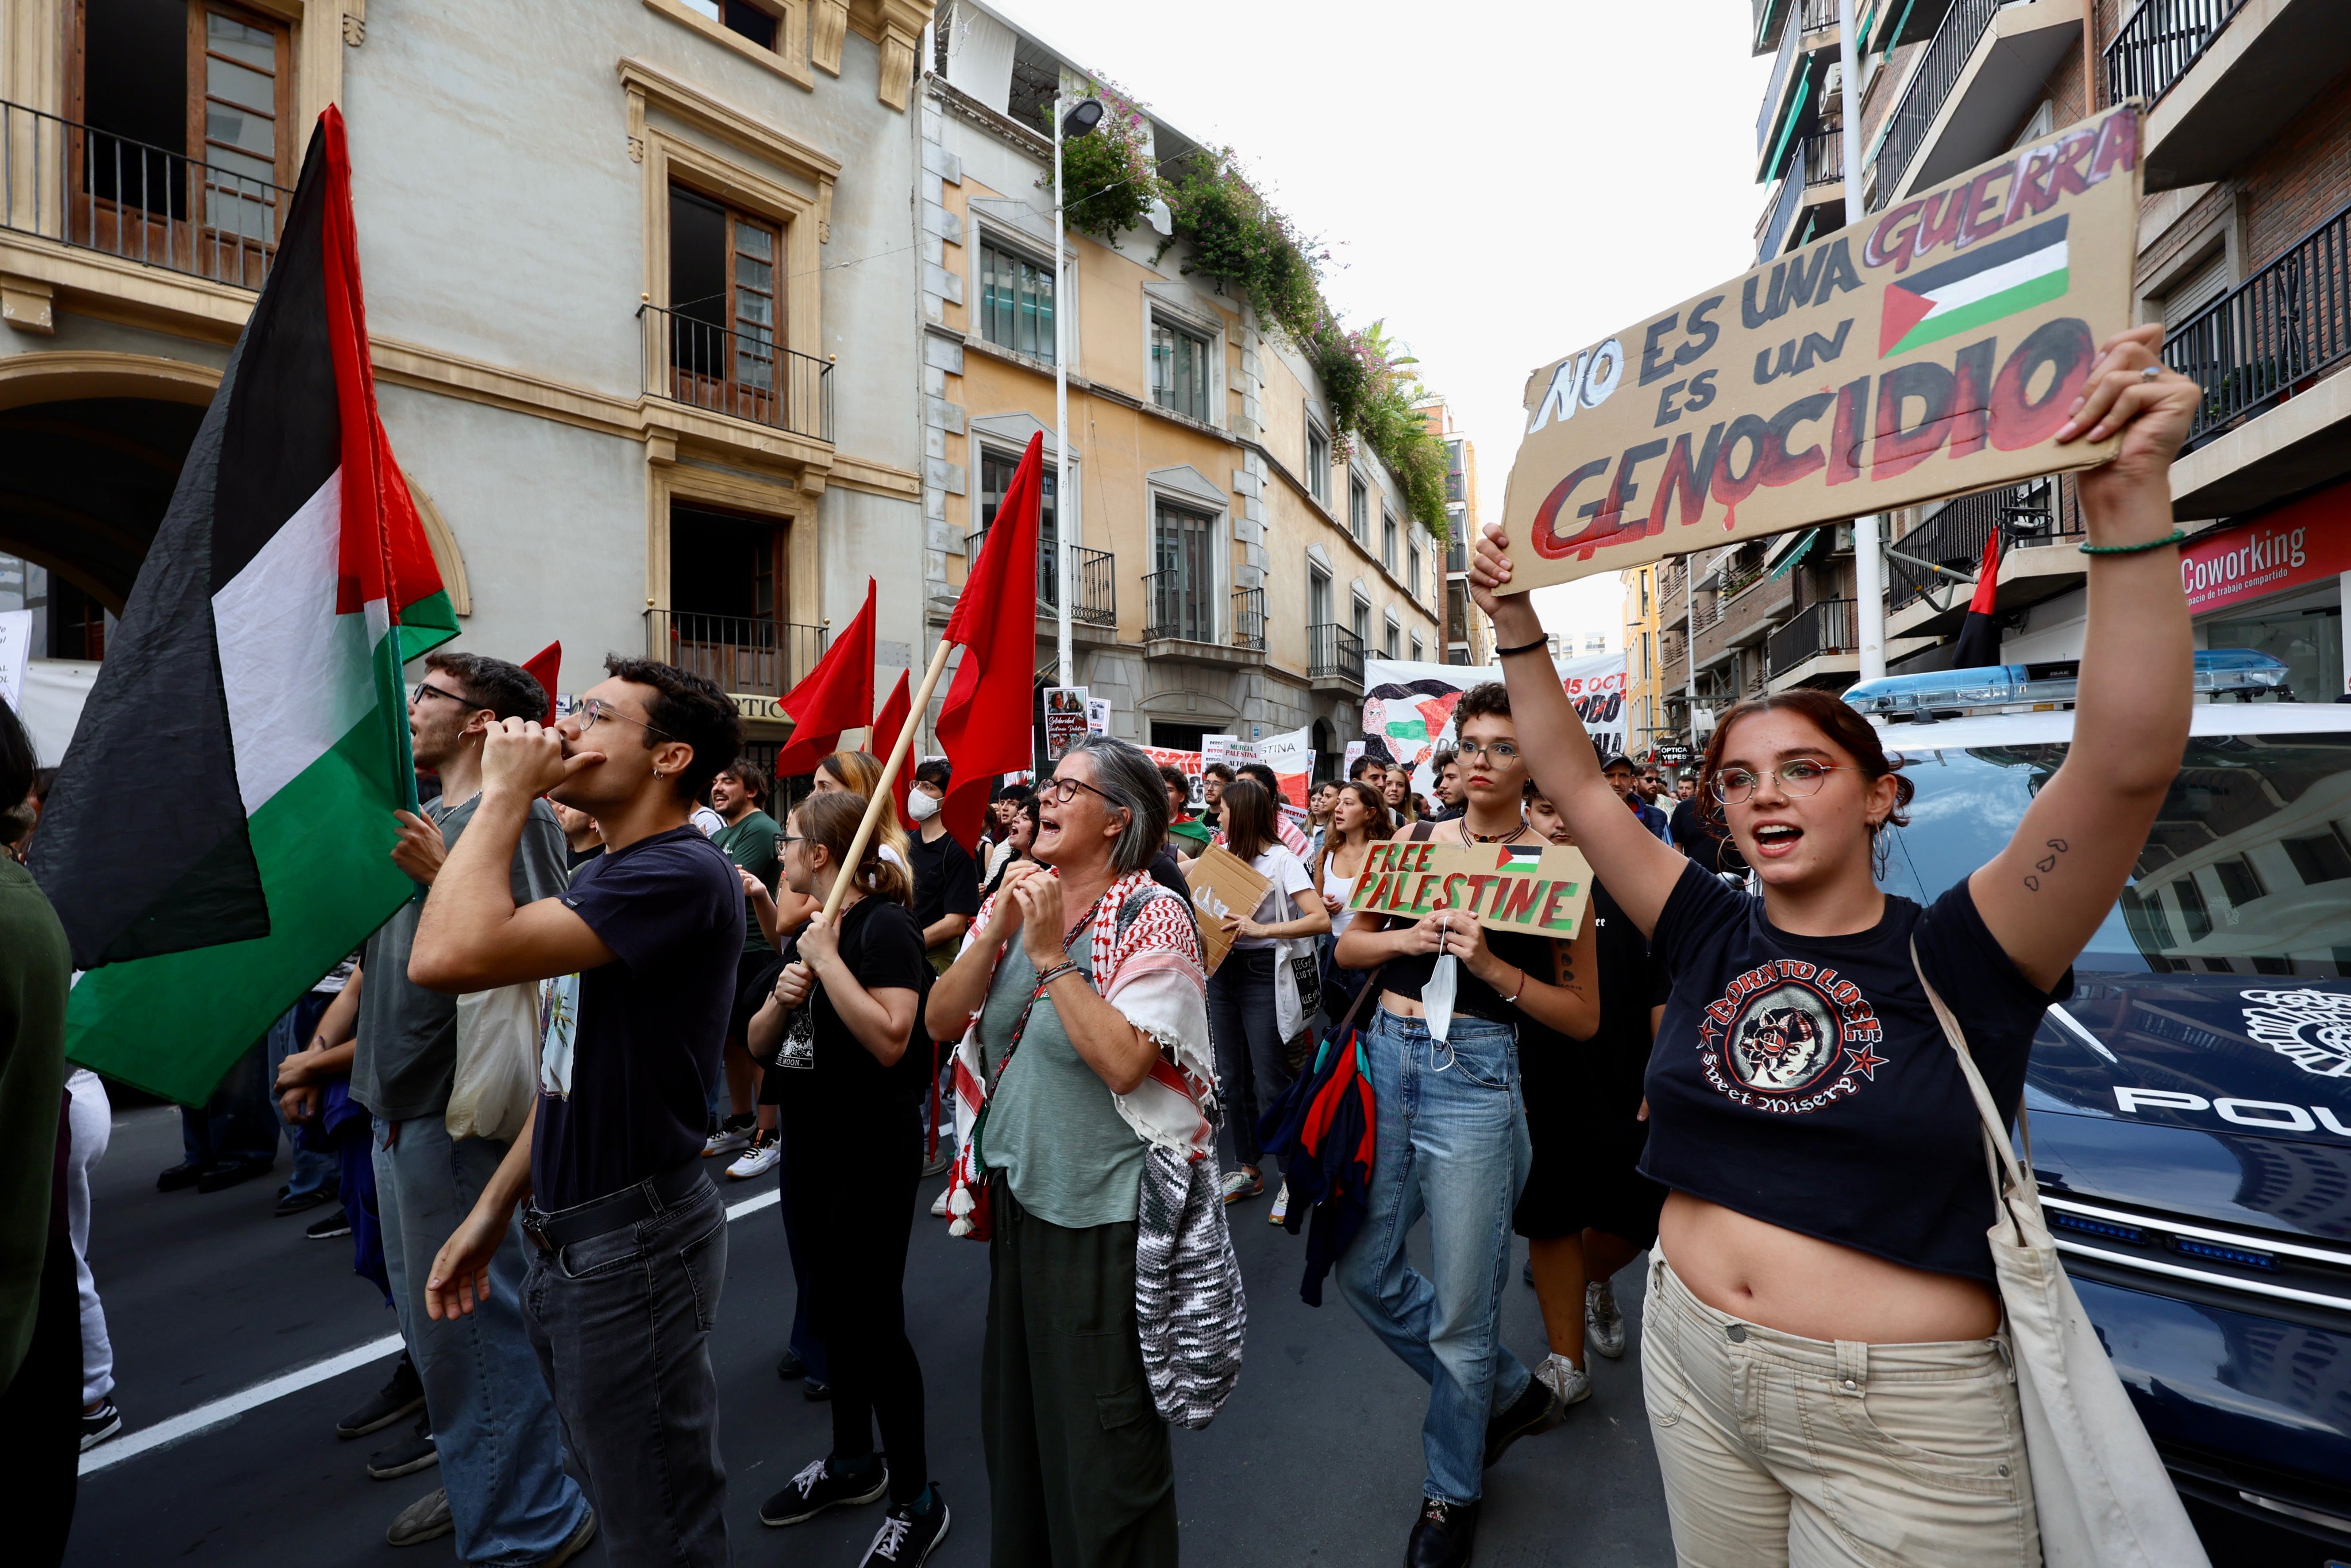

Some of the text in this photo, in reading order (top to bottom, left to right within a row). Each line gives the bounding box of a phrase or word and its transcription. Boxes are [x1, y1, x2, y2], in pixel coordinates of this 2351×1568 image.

[1528, 108, 2138, 434] NO ES UNA GUERRA
[1654, 318, 1855, 428] ES UN
[1531, 317, 2094, 562] GENOCIDIO
[2181, 526, 2306, 594] Coworking
[2207, 590, 2216, 598] de
[2218, 582, 2242, 596] trabajo
[2245, 567, 2288, 588] compartido
[1563, 673, 1627, 694] 15 OCT
[1049, 716, 1076, 725] Solidaridad
[1225, 750, 1257, 758] PALESTINA
[1231, 744, 1253, 752] MURCIA
[1363, 844, 1436, 873] FREE
[1349, 872, 1579, 930] PALESTINE
[1705, 960, 1882, 1042] BORN TO LOSE
